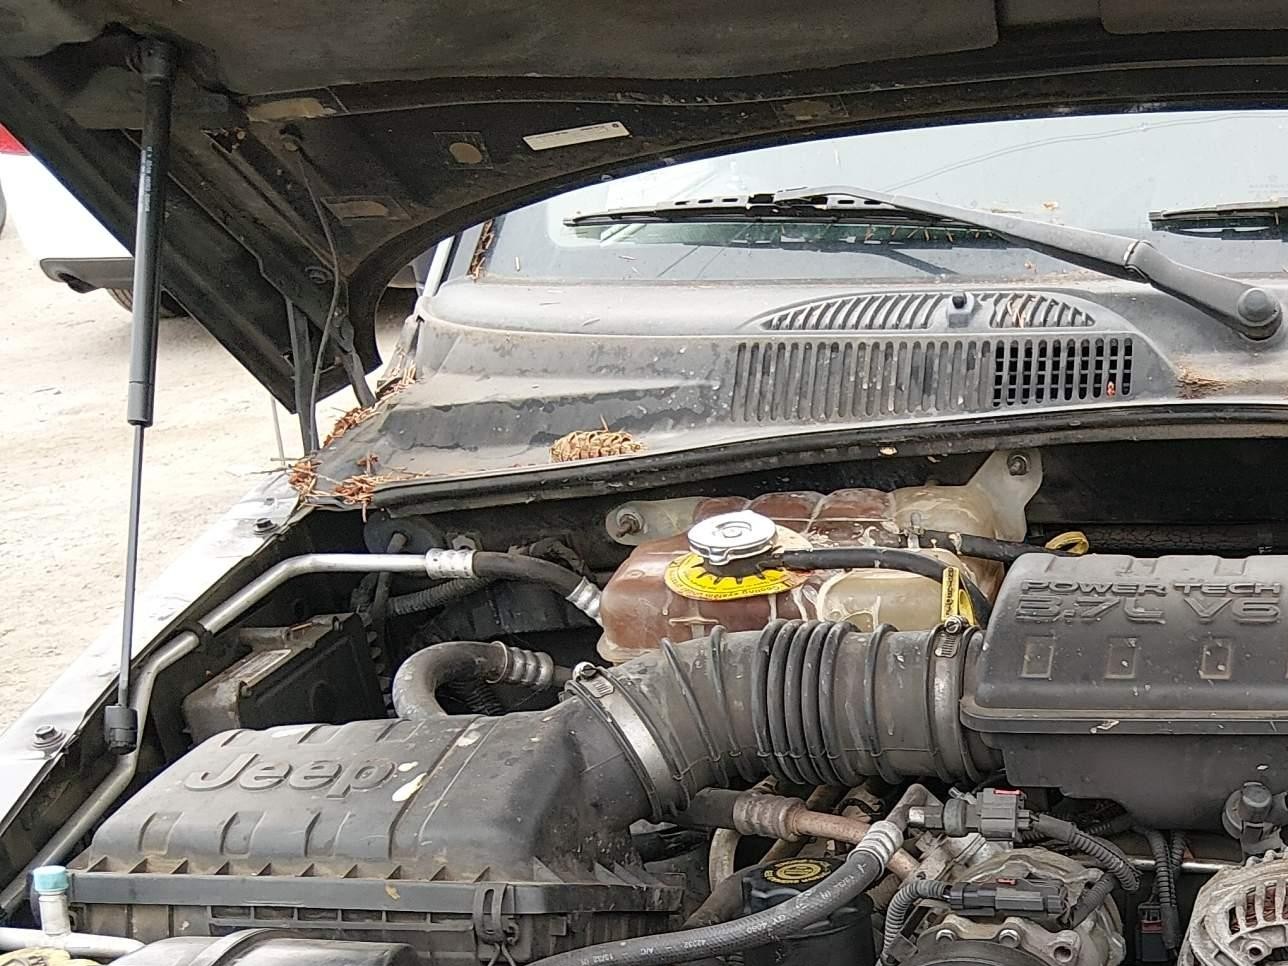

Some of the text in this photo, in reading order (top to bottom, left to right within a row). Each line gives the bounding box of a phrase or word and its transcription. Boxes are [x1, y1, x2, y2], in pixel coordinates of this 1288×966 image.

[1020, 580, 1282, 597] POWER TECH
[1183, 597, 1282, 625] V6
[183, 752, 396, 800] Jeep
